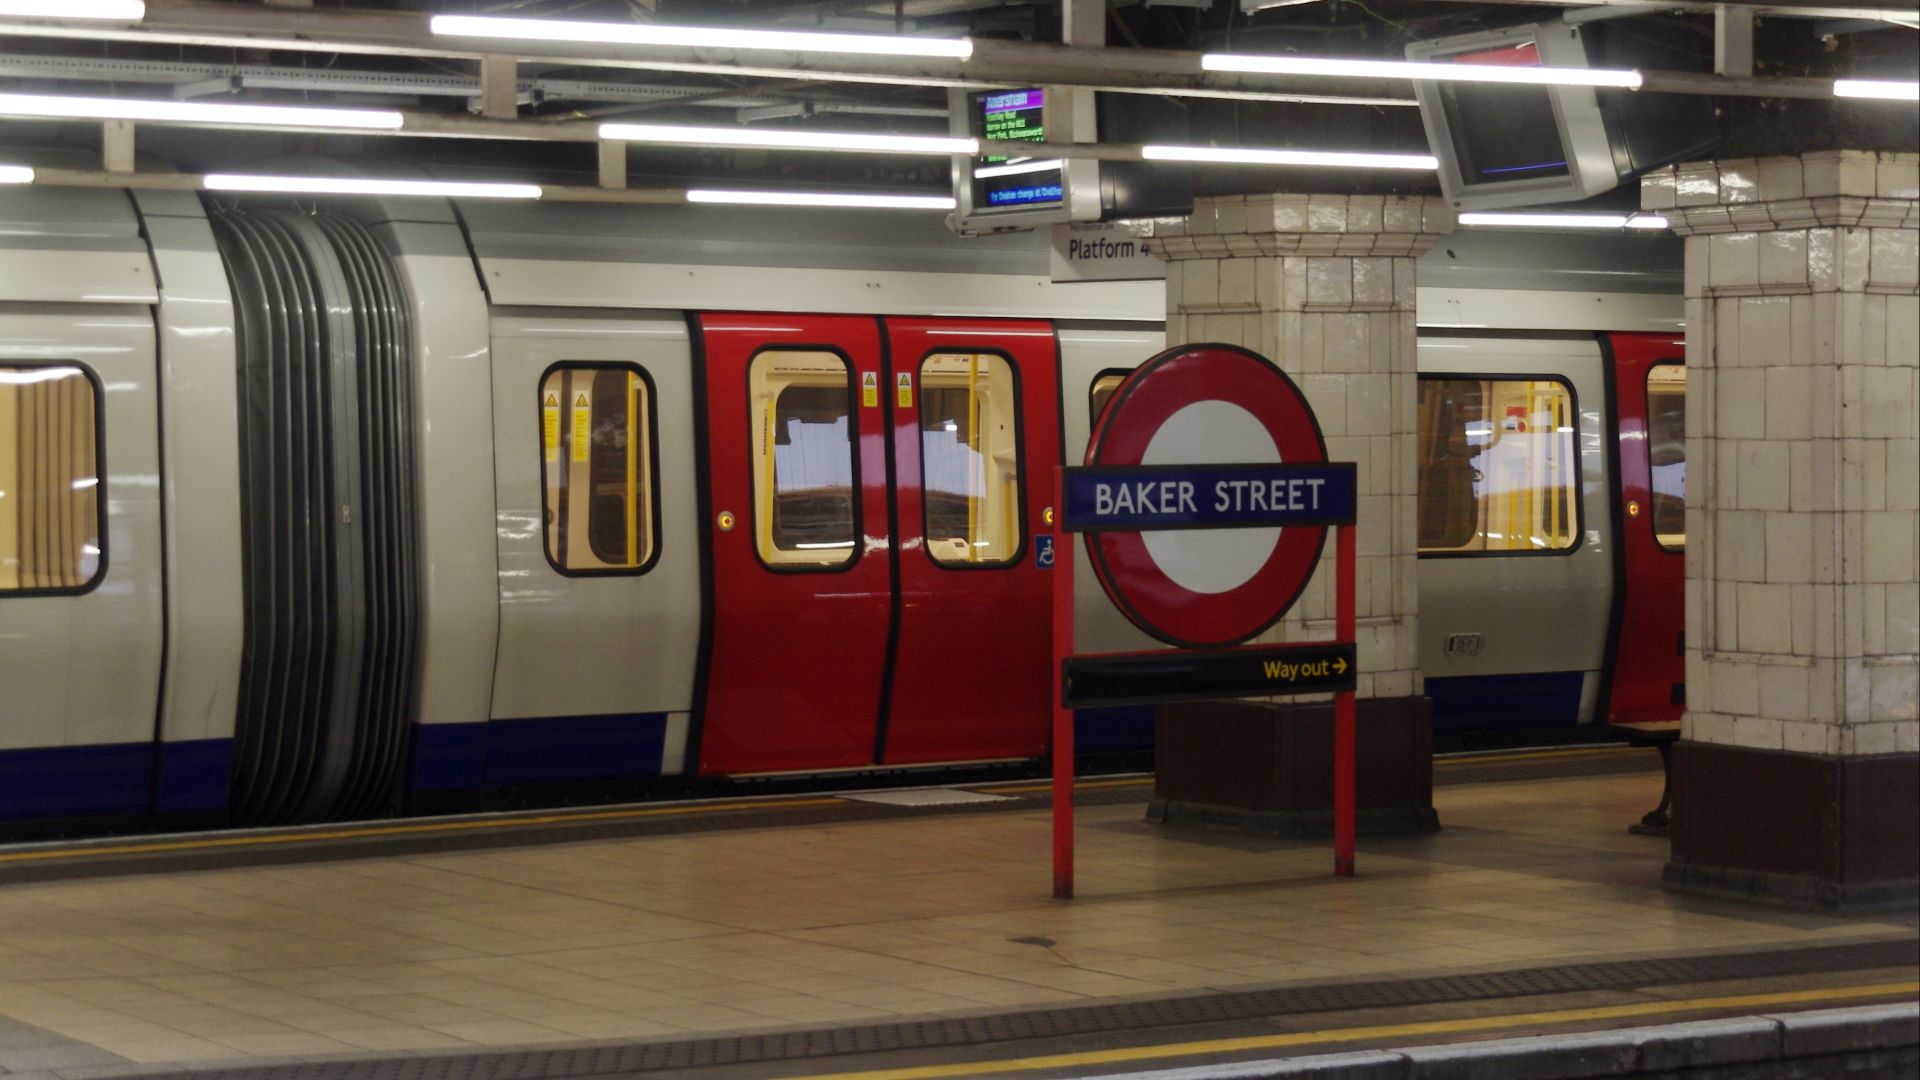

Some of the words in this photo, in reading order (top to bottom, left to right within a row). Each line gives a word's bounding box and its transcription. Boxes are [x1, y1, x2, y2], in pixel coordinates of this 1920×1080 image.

[1069, 237, 1135, 260] Platform
[1140, 242, 1150, 257] 4
[1095, 481, 1198, 515] BAKER
[1214, 478, 1325, 512] STREET
[1263, 660, 1299, 682] Way
[1301, 659, 1330, 677] out
